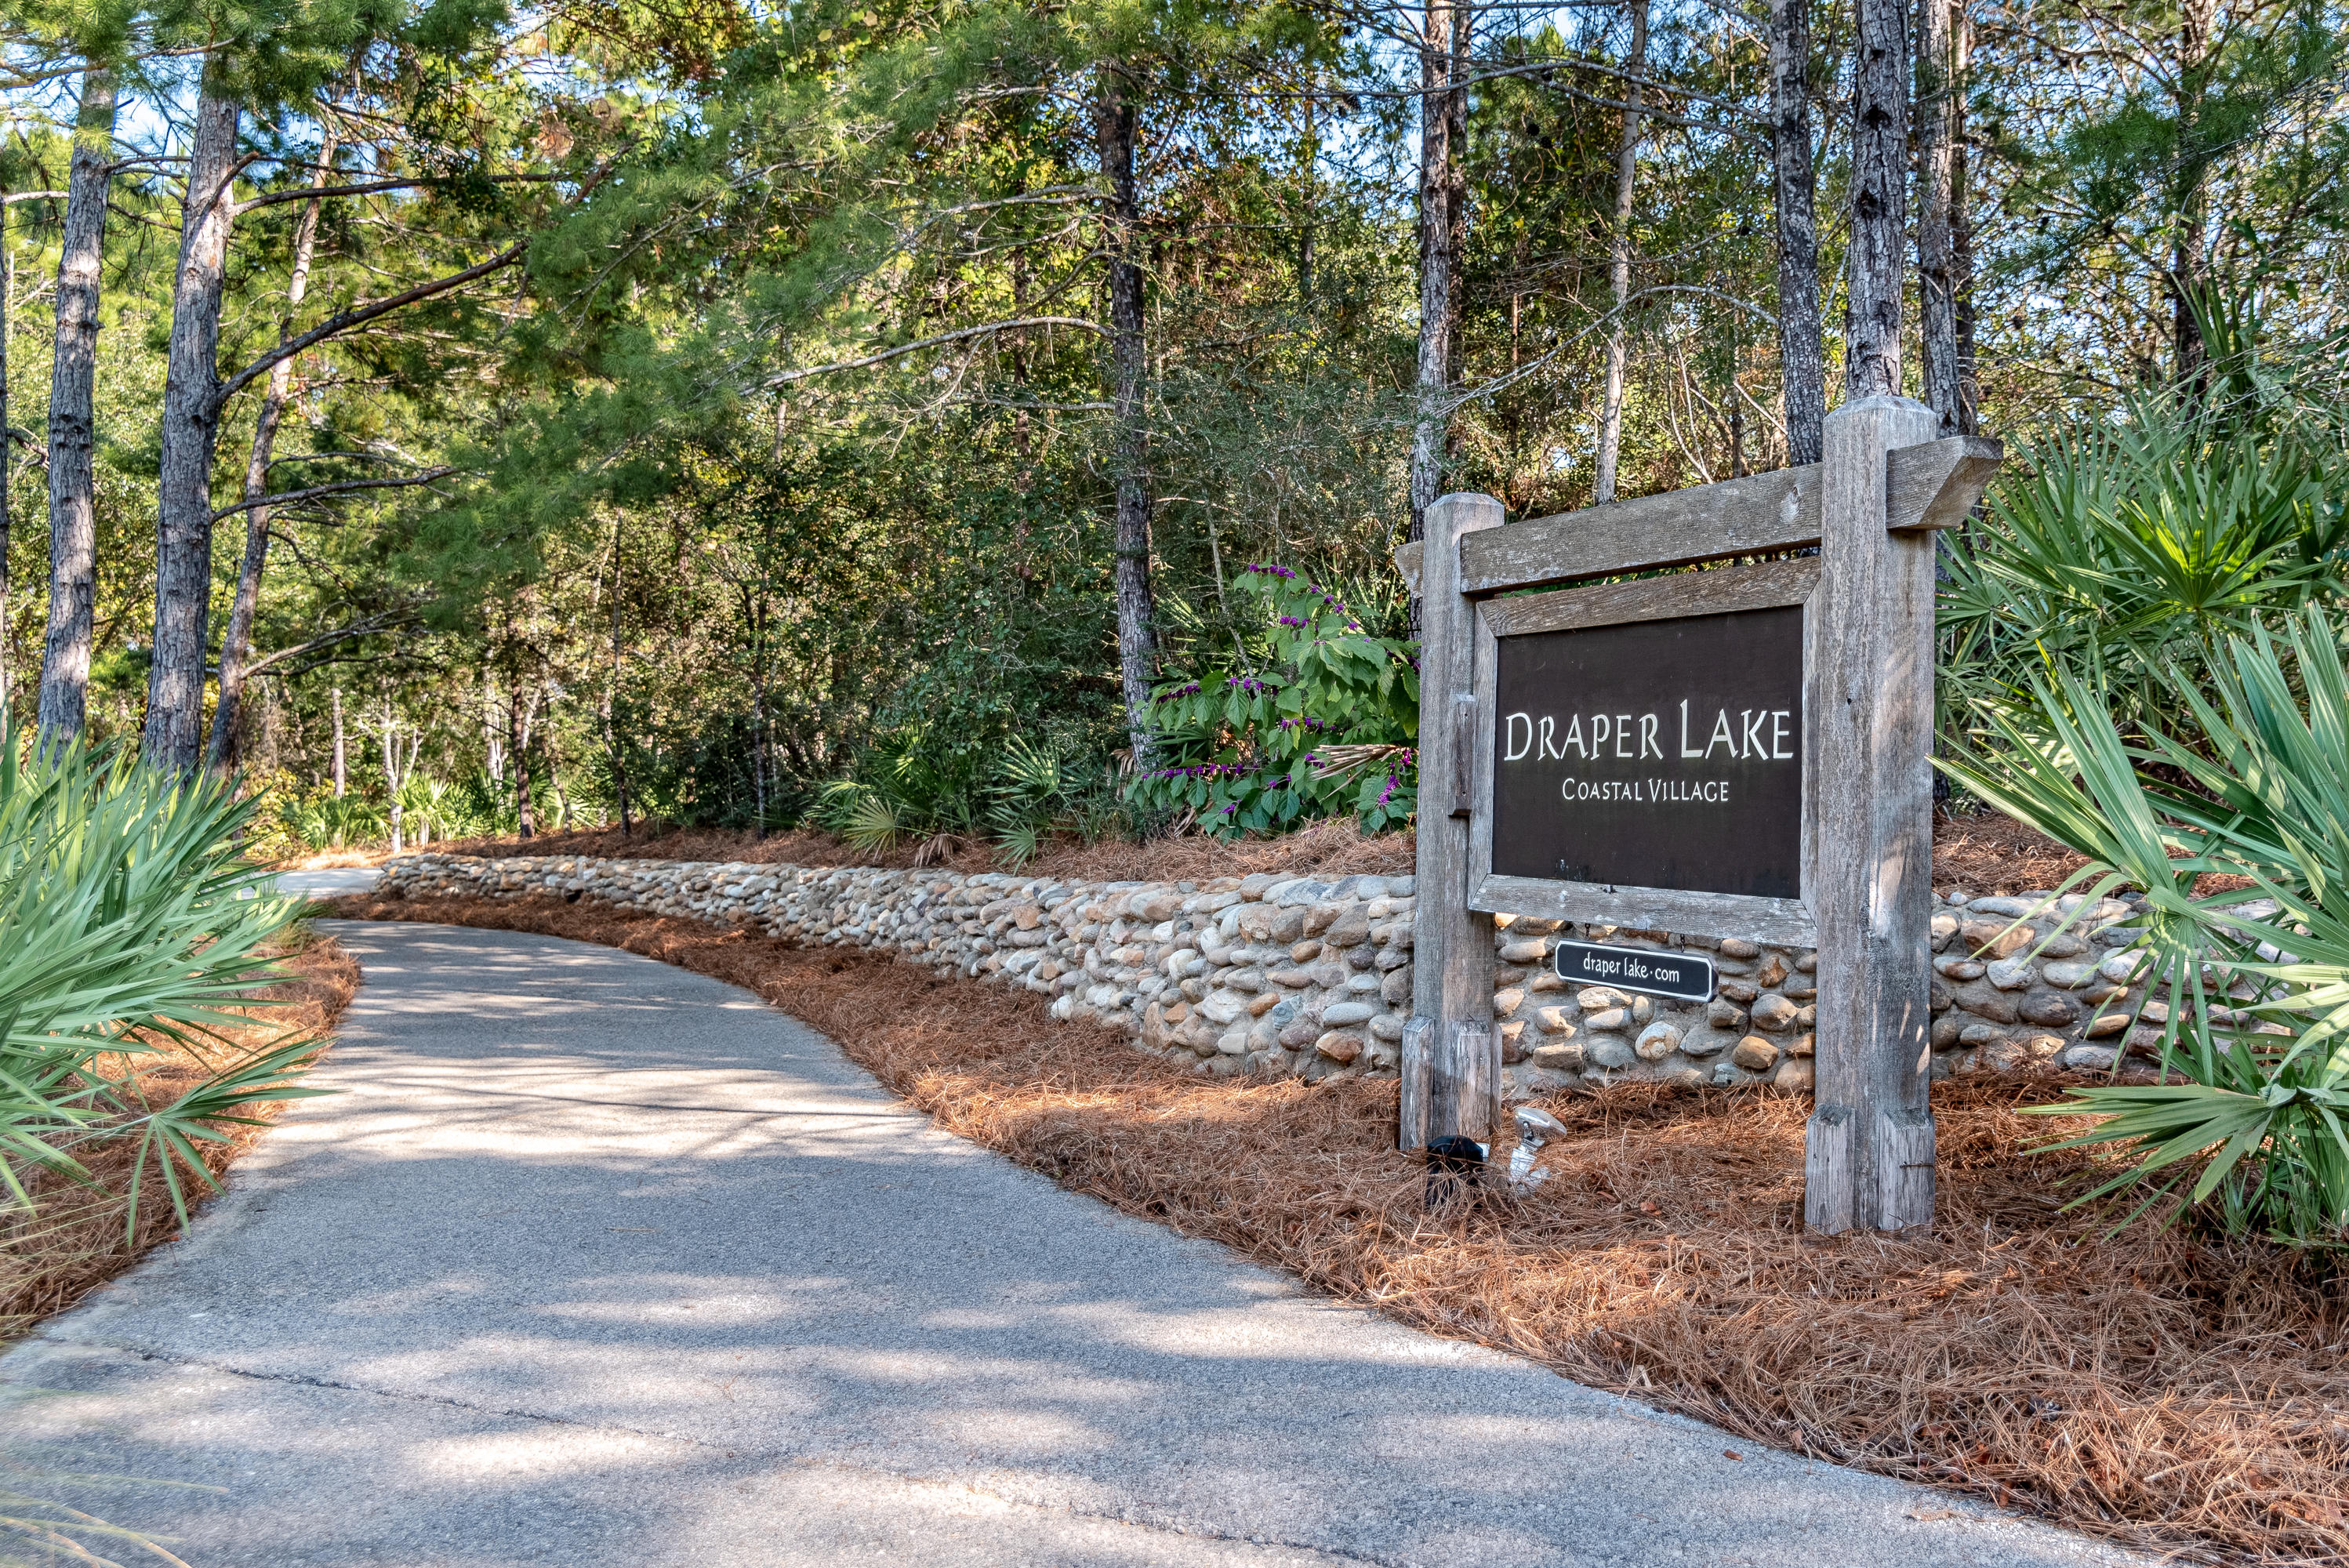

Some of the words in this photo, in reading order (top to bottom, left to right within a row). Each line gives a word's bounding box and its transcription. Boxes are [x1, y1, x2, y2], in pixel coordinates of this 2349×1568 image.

[1504, 712, 1663, 761] DRAPER
[1680, 699, 1794, 760] LAKE
[1562, 778, 1643, 802] COASTAL
[1647, 778, 1730, 803] VILLAGE
[1583, 951, 1621, 977] draper
